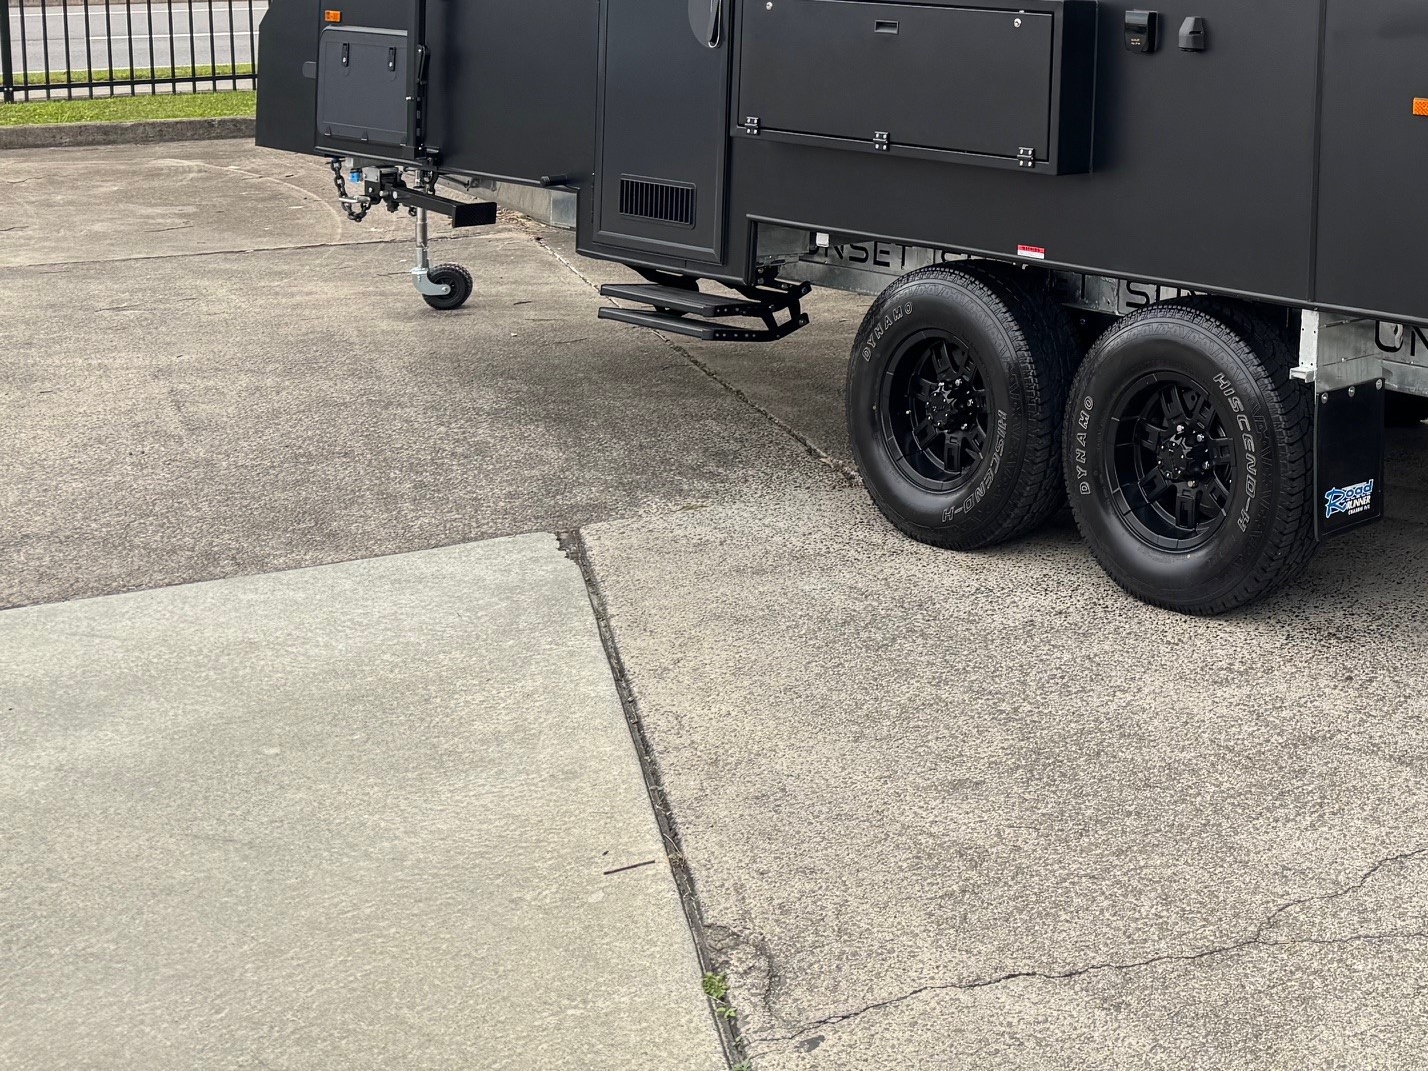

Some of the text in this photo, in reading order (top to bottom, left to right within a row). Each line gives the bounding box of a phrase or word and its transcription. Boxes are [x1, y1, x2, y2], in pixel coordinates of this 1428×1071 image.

[862, 301, 914, 363] DYNAMO
[941, 409, 1008, 523] HISCEND-H
[1075, 395, 1095, 495] DYNAMO
[1213, 371, 1258, 533] HISCEND-H
[1324, 478, 1375, 519] Road
